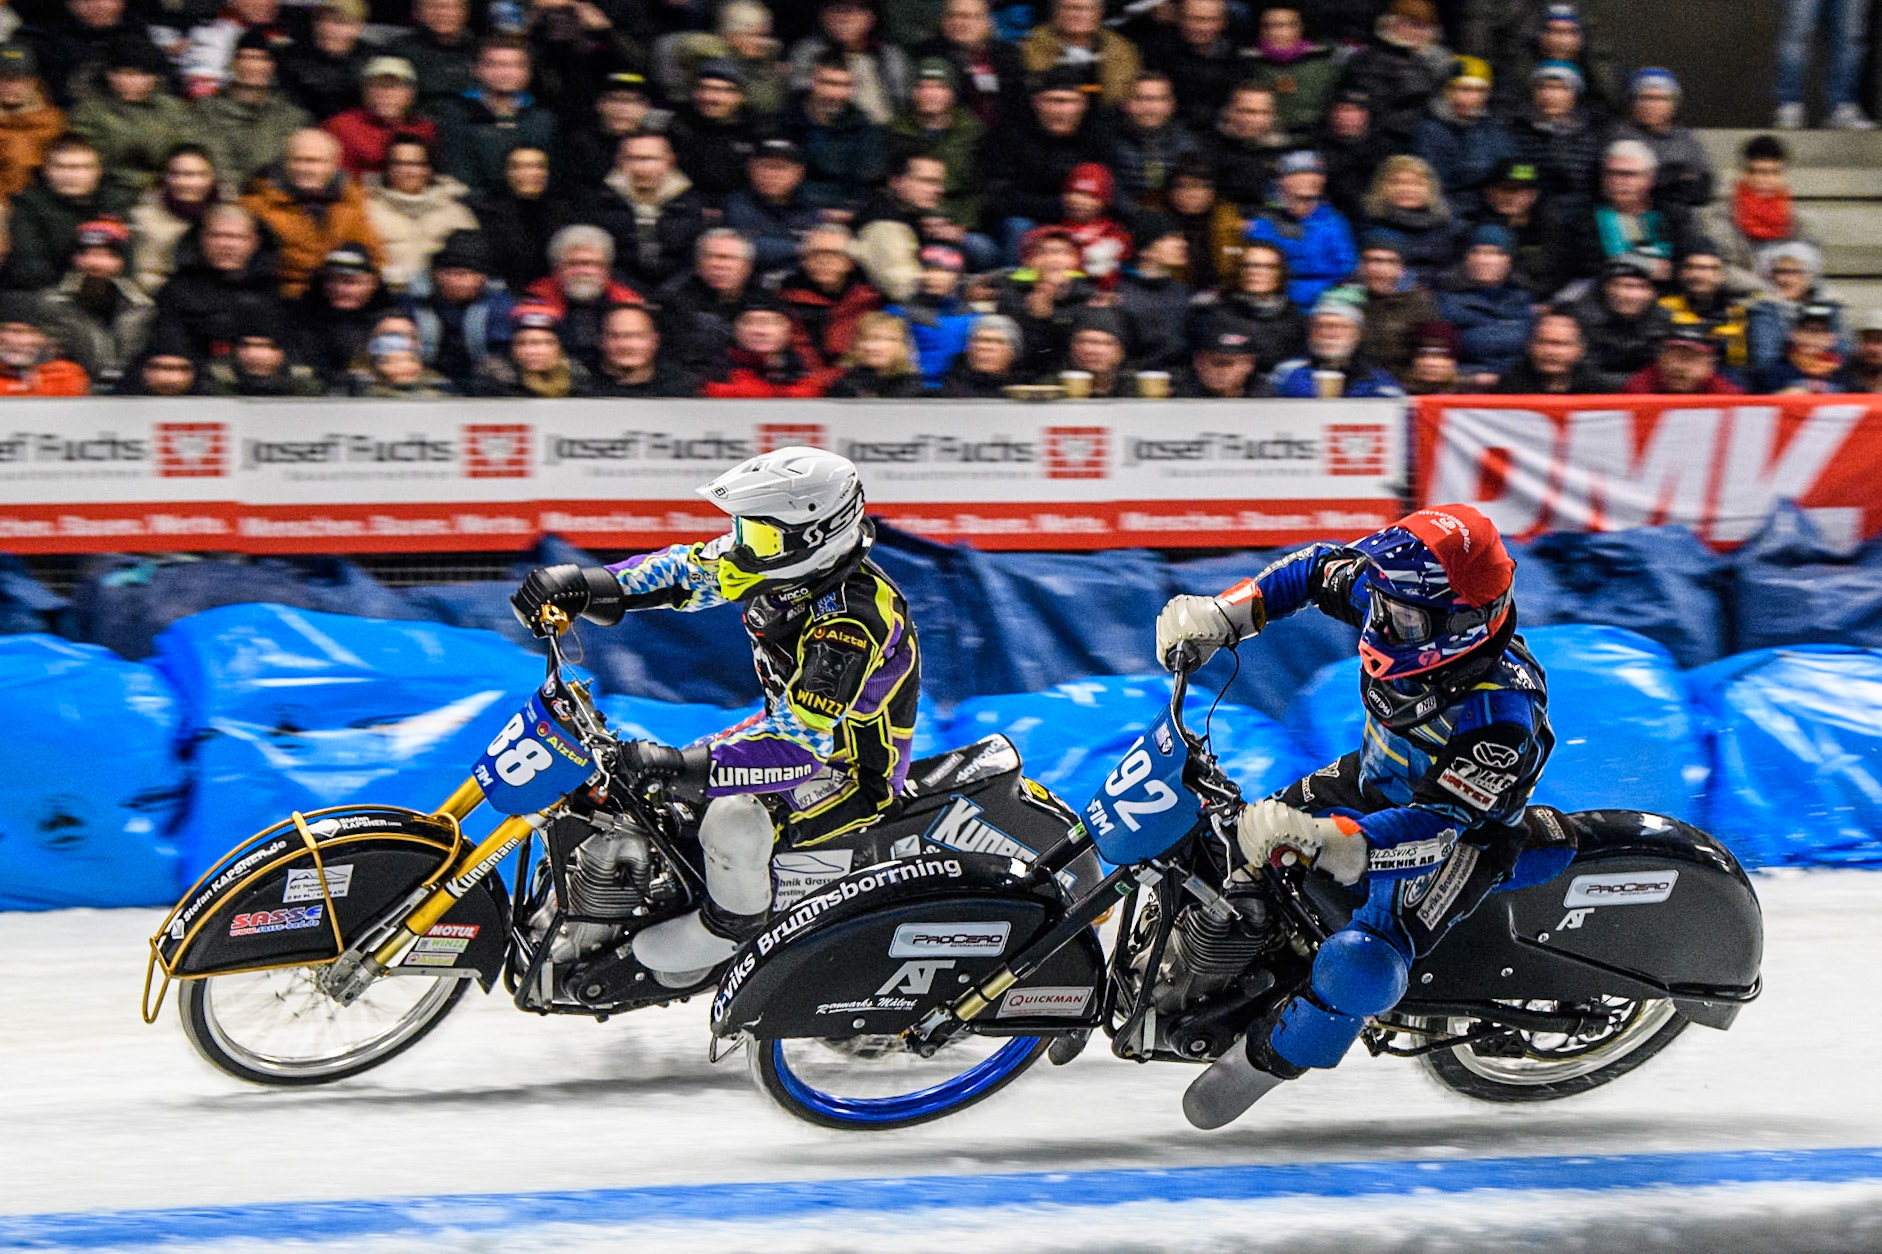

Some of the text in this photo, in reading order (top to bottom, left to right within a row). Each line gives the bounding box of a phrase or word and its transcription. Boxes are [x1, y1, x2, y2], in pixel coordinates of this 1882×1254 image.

[826, 629, 868, 649] Alztal
[797, 689, 845, 718] WINZZ
[545, 737, 590, 768] Alztal
[1086, 797, 1116, 837] FIM
[445, 836, 521, 899] Kunemann
[183, 889, 214, 922] Stefan
[230, 904, 324, 930] SASSE
[757, 858, 963, 957] Brunnsborrning
[428, 924, 476, 938] MOTUL
[1009, 995, 1084, 1007] QUICKMAN
